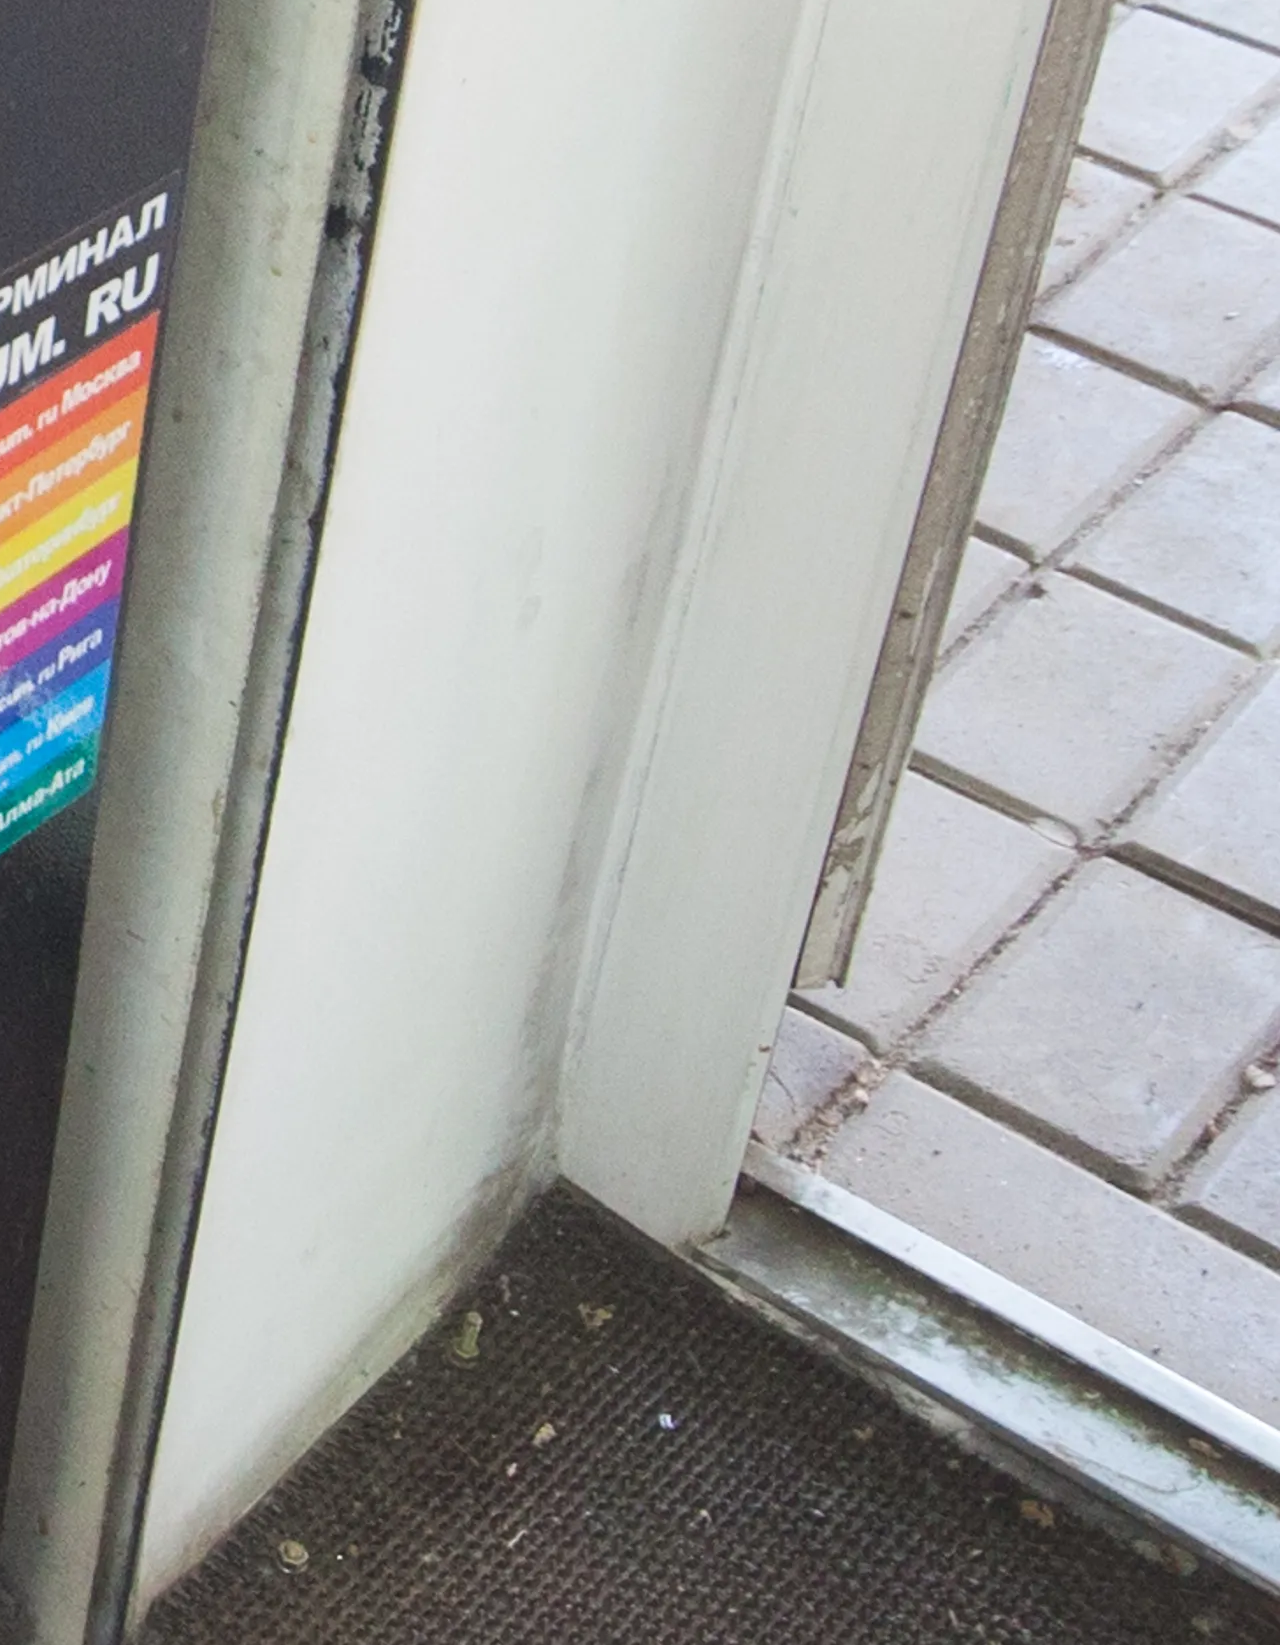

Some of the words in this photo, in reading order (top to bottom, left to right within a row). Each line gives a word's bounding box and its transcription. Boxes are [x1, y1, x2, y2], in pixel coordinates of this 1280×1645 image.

[83, 253, 160, 337] RU
[59, 343, 143, 416] Москва
[54, 622, 104, 672] Рига
